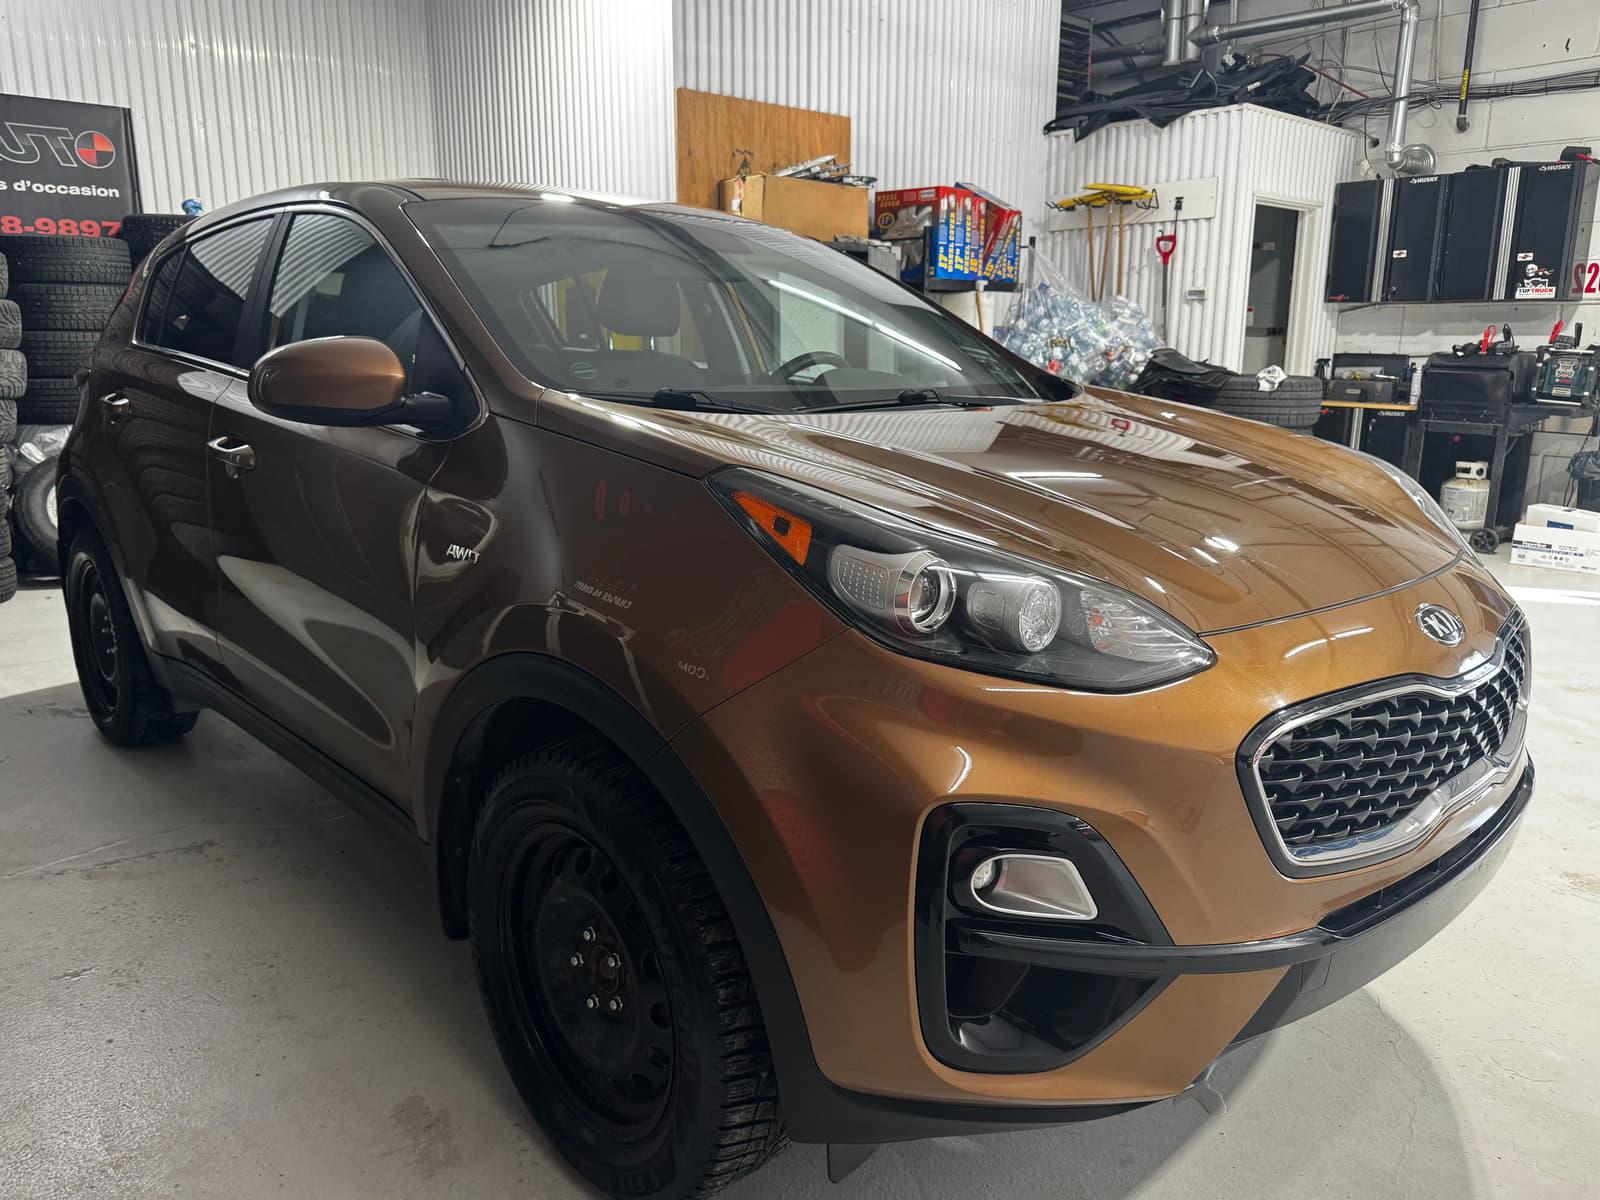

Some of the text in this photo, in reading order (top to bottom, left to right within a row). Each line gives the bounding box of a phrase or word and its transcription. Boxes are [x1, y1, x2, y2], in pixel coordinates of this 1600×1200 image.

[0, 121, 116, 169] UTO
[13, 179, 120, 198] d'occasion
[0, 214, 122, 238] 8-9897
[1584, 262, 1600, 293] 2
